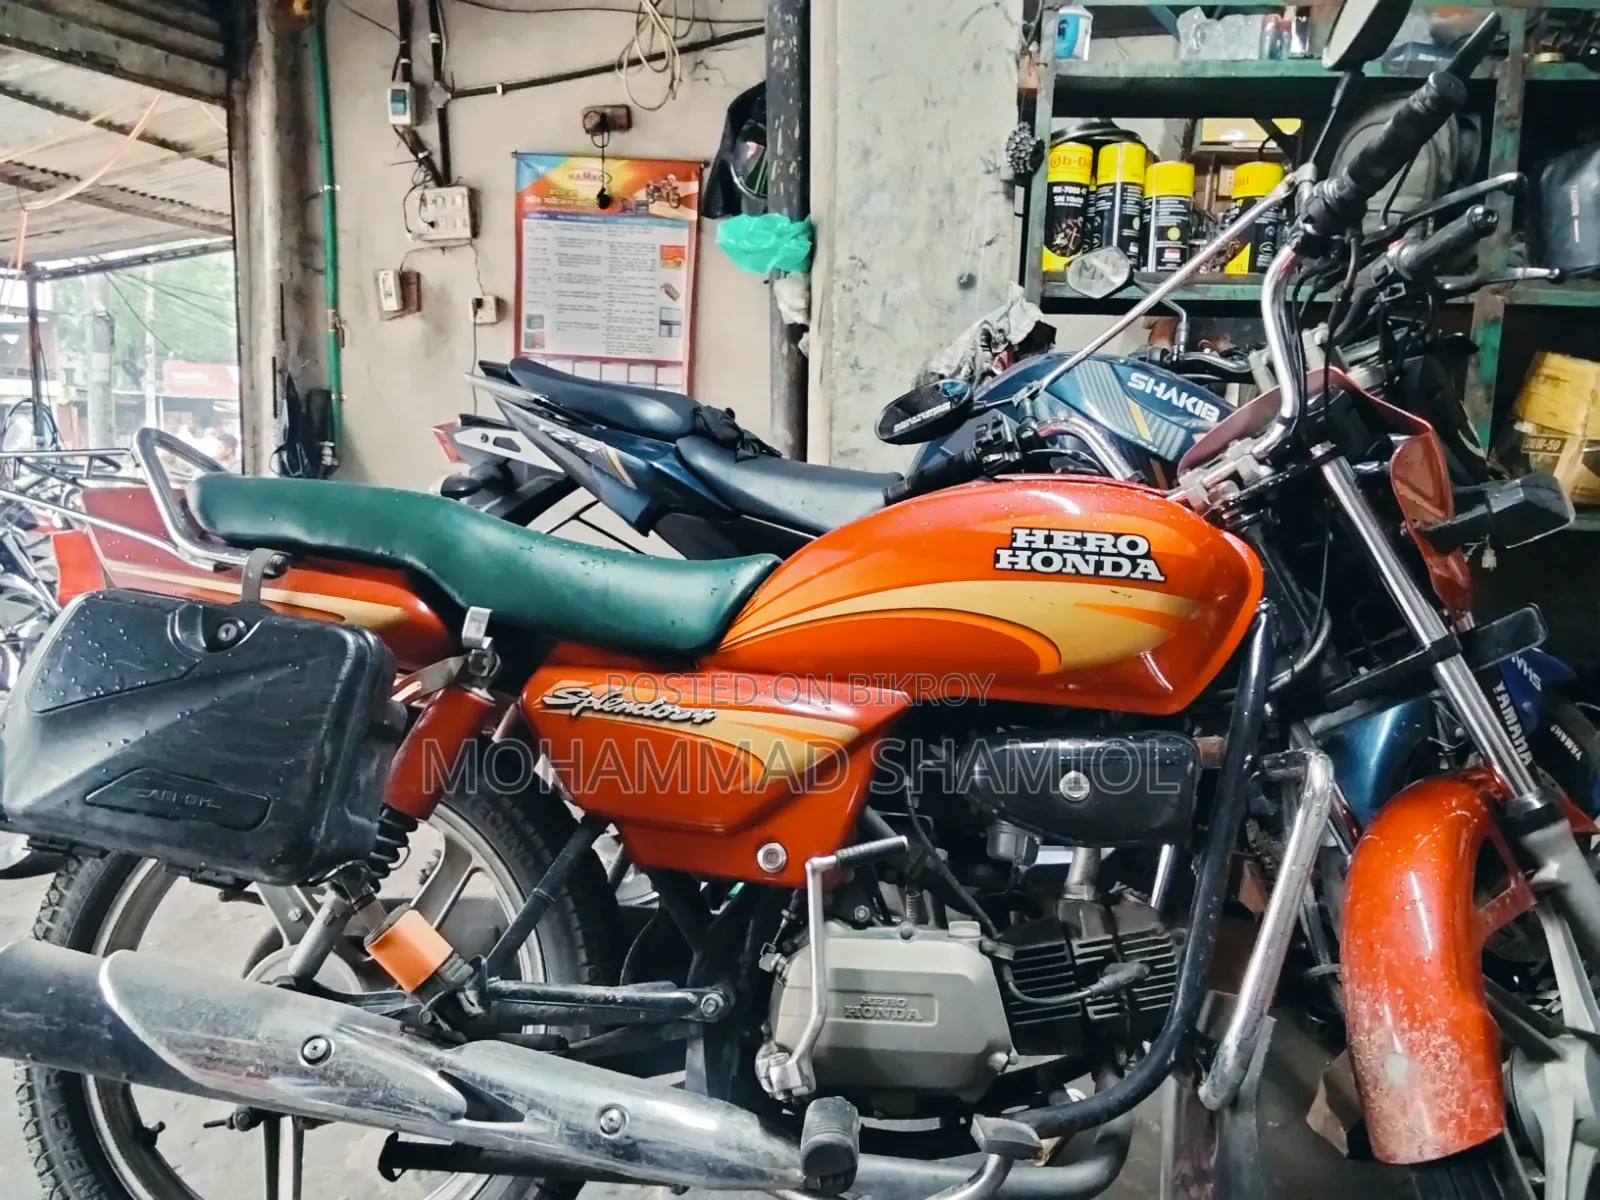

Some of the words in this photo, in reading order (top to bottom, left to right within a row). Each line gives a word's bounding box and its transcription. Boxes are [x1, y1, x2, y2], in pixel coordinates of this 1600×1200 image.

[1127, 372, 1220, 422] SHAKIB
[1012, 528, 1149, 556] HERO
[995, 549, 1166, 581] HONDA
[844, 1005, 923, 1022] HONDA
[860, 996, 907, 1007] HERO
